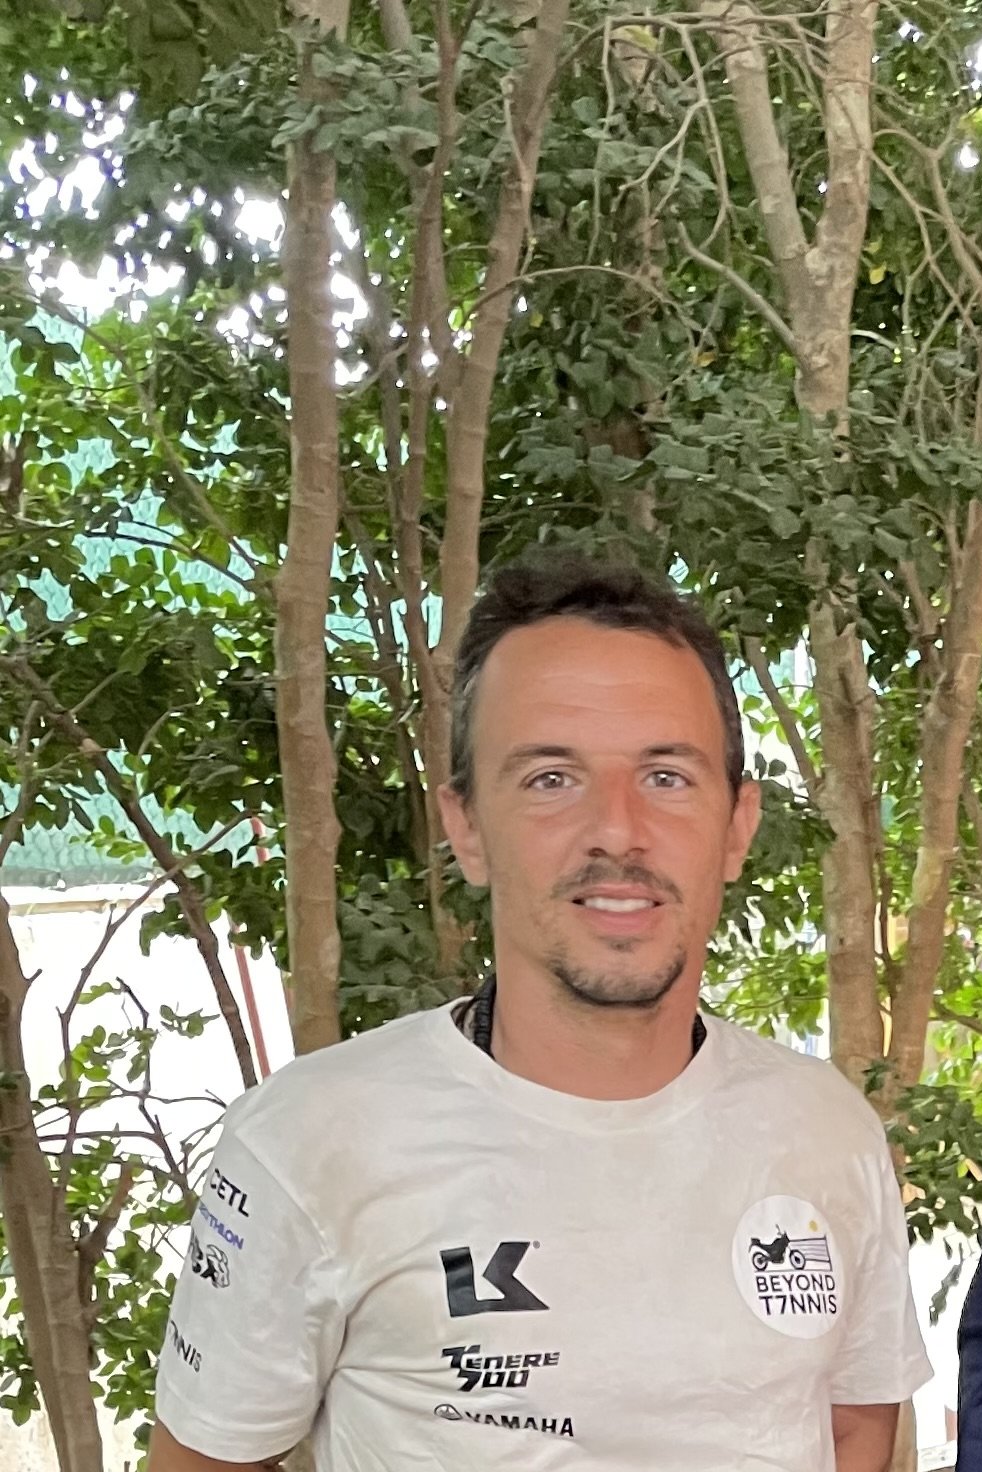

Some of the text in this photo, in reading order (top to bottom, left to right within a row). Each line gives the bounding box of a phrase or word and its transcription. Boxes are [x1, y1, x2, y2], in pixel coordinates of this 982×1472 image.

[755, 1274, 836, 1293] BEYOND
[758, 1294, 837, 1315] T7NNIS
[464, 1410, 574, 1437] YAMAHA
